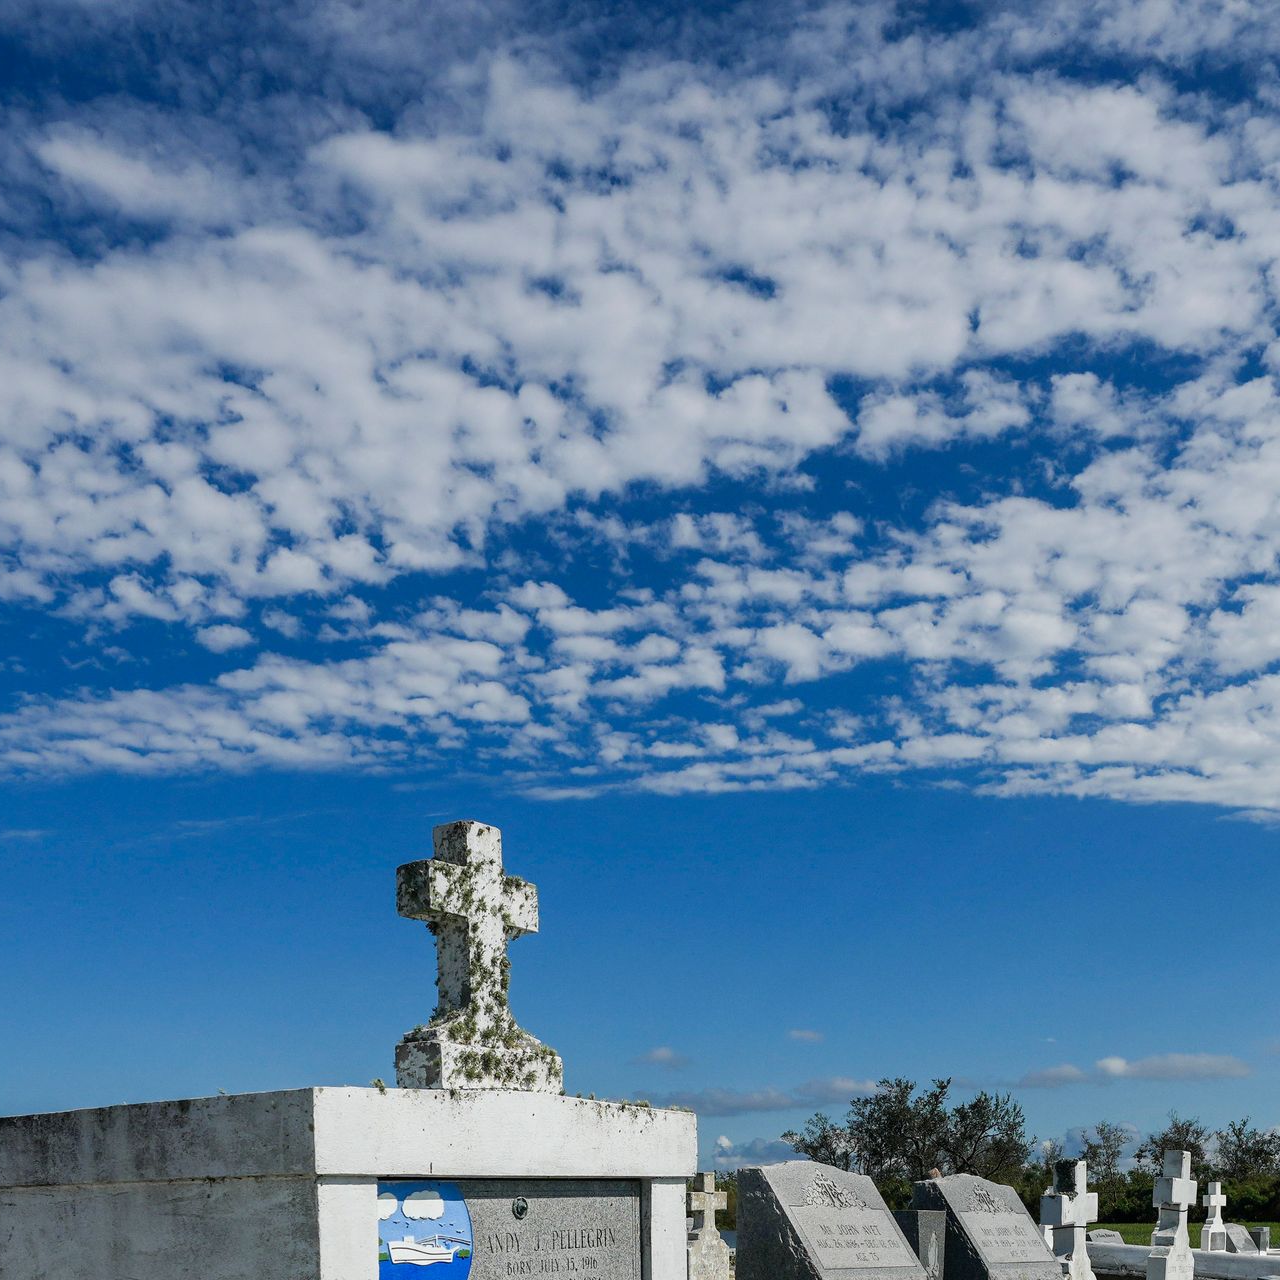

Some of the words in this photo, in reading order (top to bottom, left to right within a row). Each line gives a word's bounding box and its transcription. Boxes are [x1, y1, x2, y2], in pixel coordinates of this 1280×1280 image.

[836, 1224, 860, 1236] JOHN
[483, 1232, 521, 1254] ANDY
[552, 1228, 616, 1250] PELLEGRIN
[506, 1260, 532, 1276] BORN
[538, 1258, 559, 1274] JULY
[582, 1256, 598, 1269] 1916
